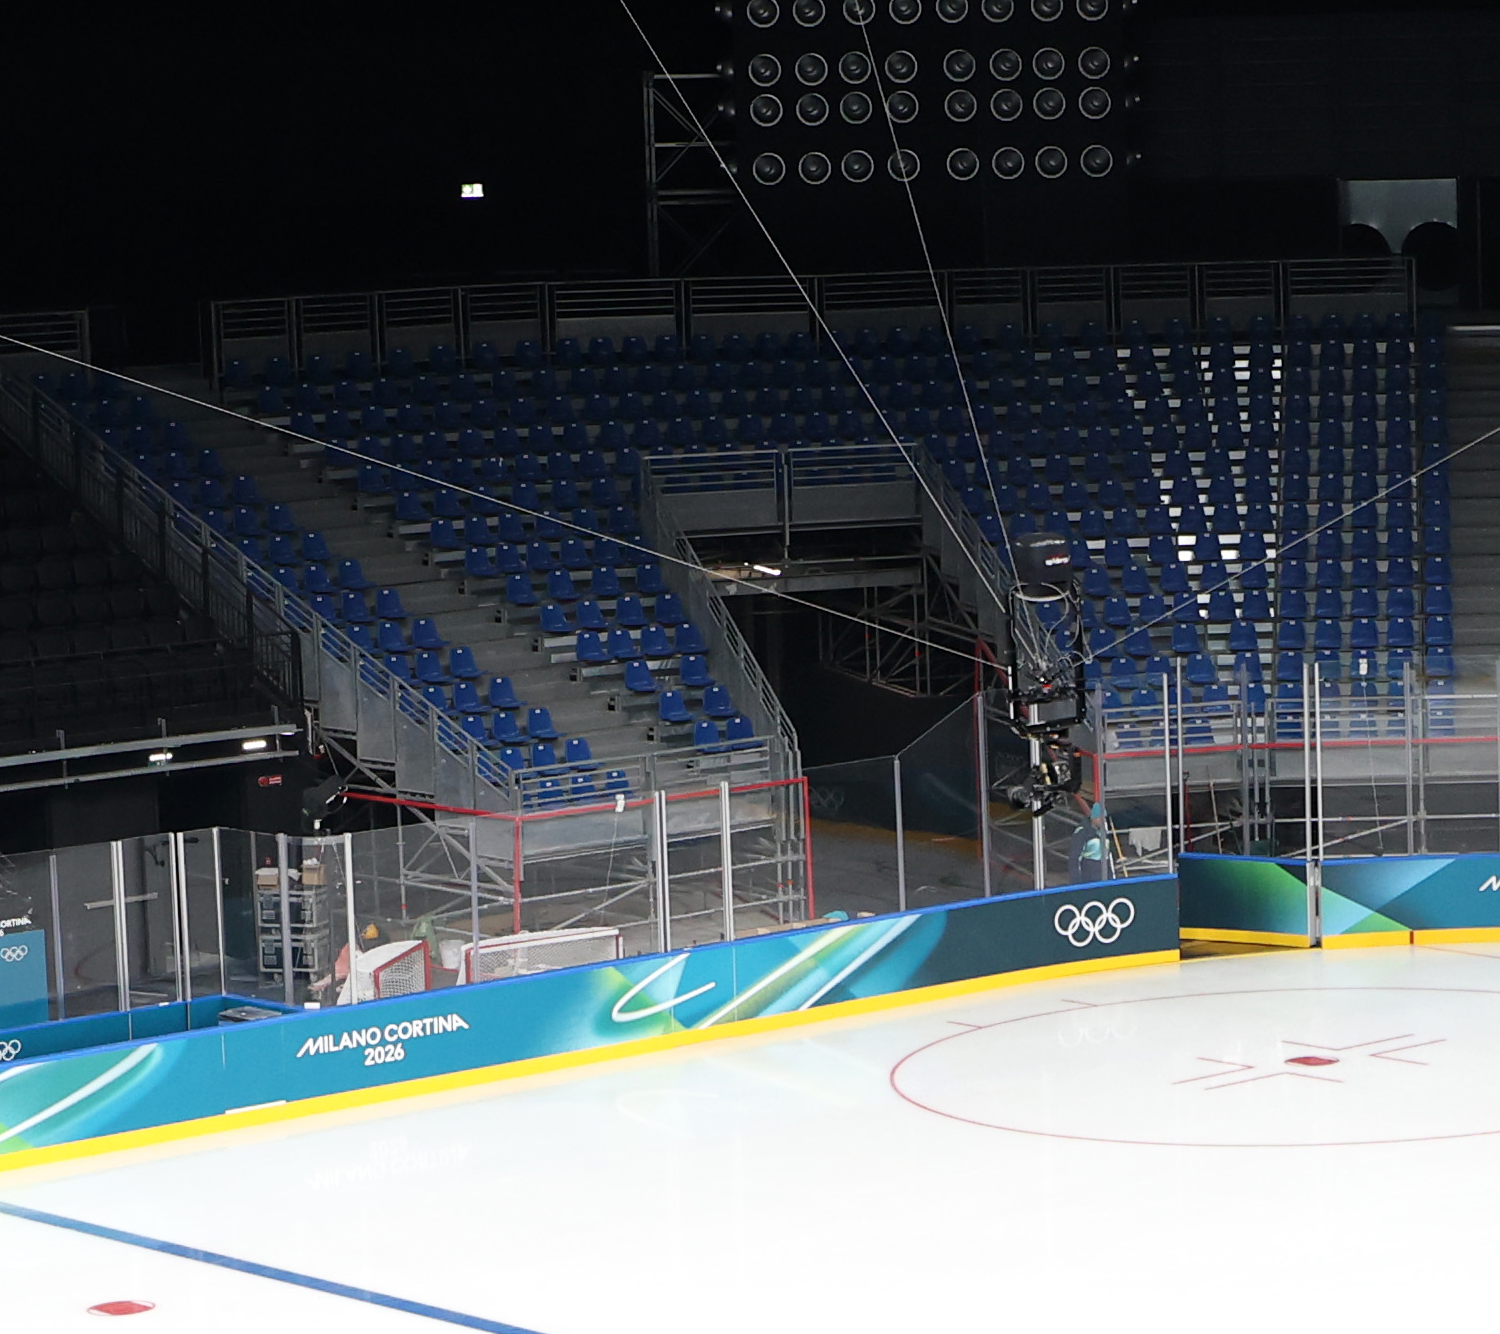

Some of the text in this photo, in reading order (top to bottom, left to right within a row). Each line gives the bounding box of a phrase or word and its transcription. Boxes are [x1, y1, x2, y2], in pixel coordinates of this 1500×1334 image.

[296, 1013, 470, 1058] MILANO CORTINA
[364, 1043, 405, 1066] 2026
